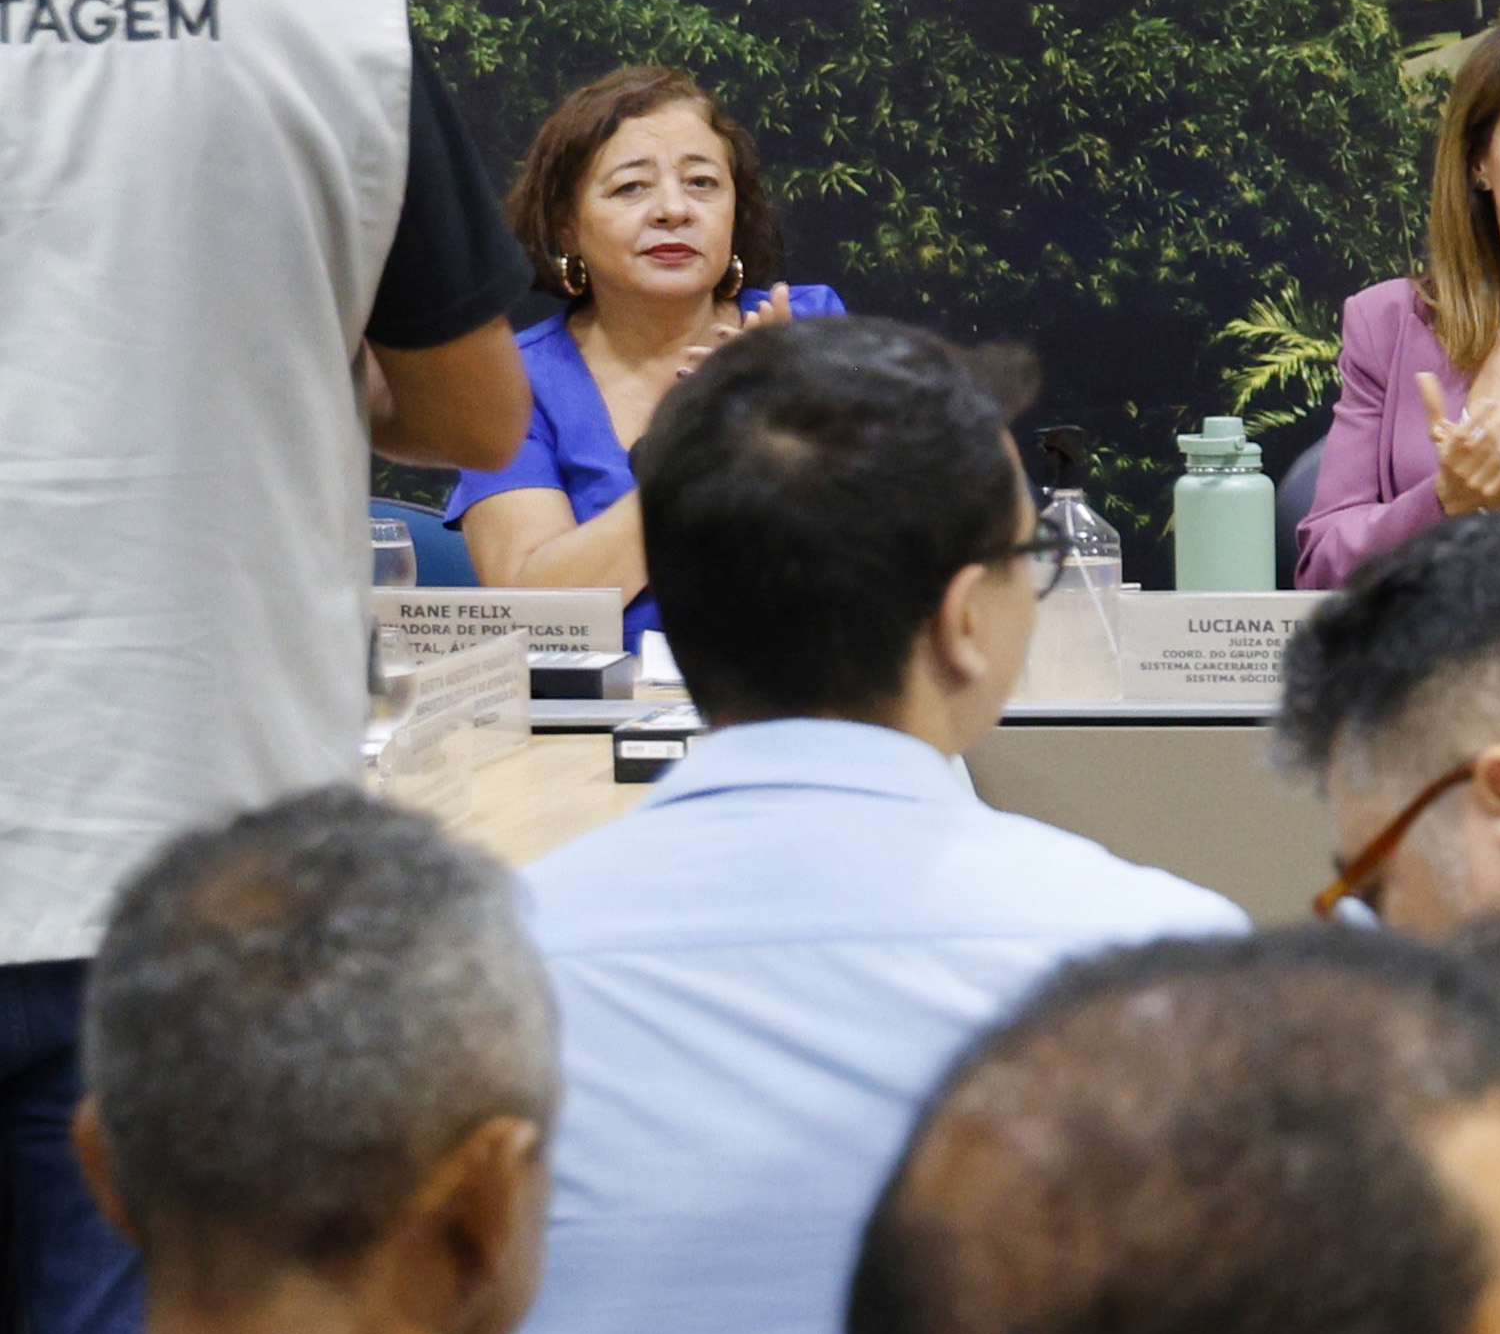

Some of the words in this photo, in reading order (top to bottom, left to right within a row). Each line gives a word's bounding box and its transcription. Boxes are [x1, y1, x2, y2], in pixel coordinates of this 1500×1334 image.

[401, 604, 451, 618] RANE
[457, 604, 512, 618] FELIX
[456, 624, 476, 636] DE
[569, 625, 589, 637] DE
[1188, 619, 1273, 634] LUCIANA
[1266, 638, 1281, 647] DE
[1209, 649, 1226, 659] DO
[1229, 649, 1270, 659] GRUPO
[1140, 661, 1191, 671] SISTEMA
[1185, 673, 1236, 683] SISTEMA
